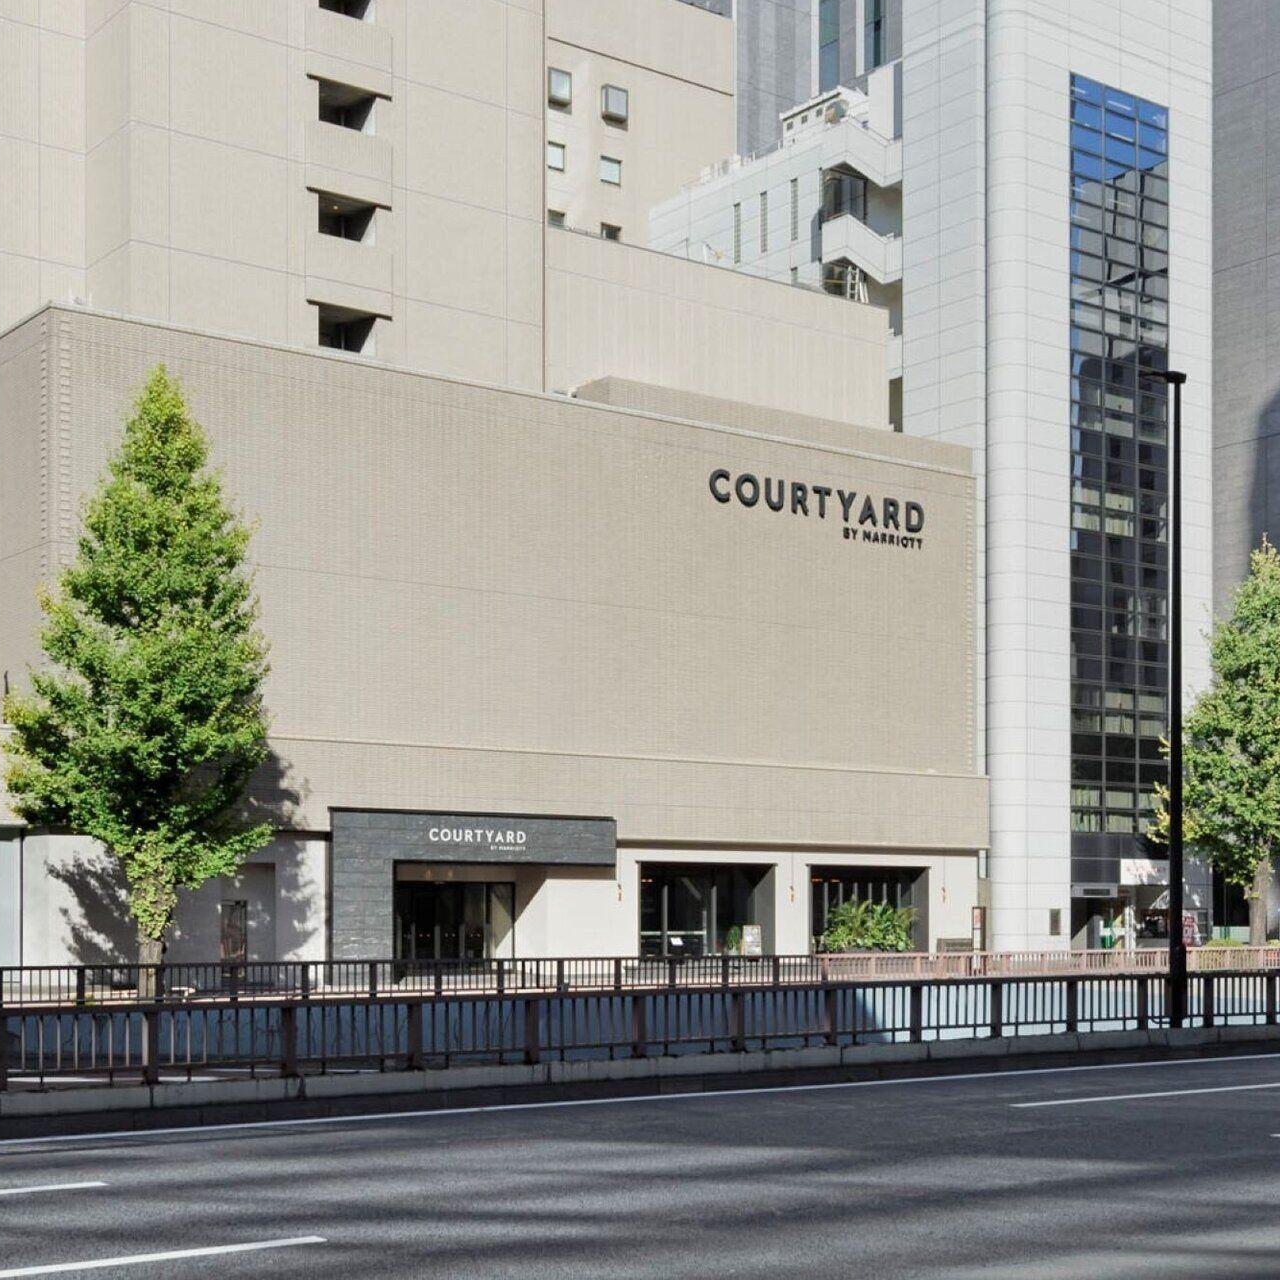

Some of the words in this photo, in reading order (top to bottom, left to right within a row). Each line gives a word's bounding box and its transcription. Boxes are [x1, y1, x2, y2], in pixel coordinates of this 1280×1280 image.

[709, 468, 925, 533] COURTYARD
[842, 526, 858, 540] BY
[862, 531, 924, 551] MARRIOTT
[428, 827, 527, 844] COURTYARD
